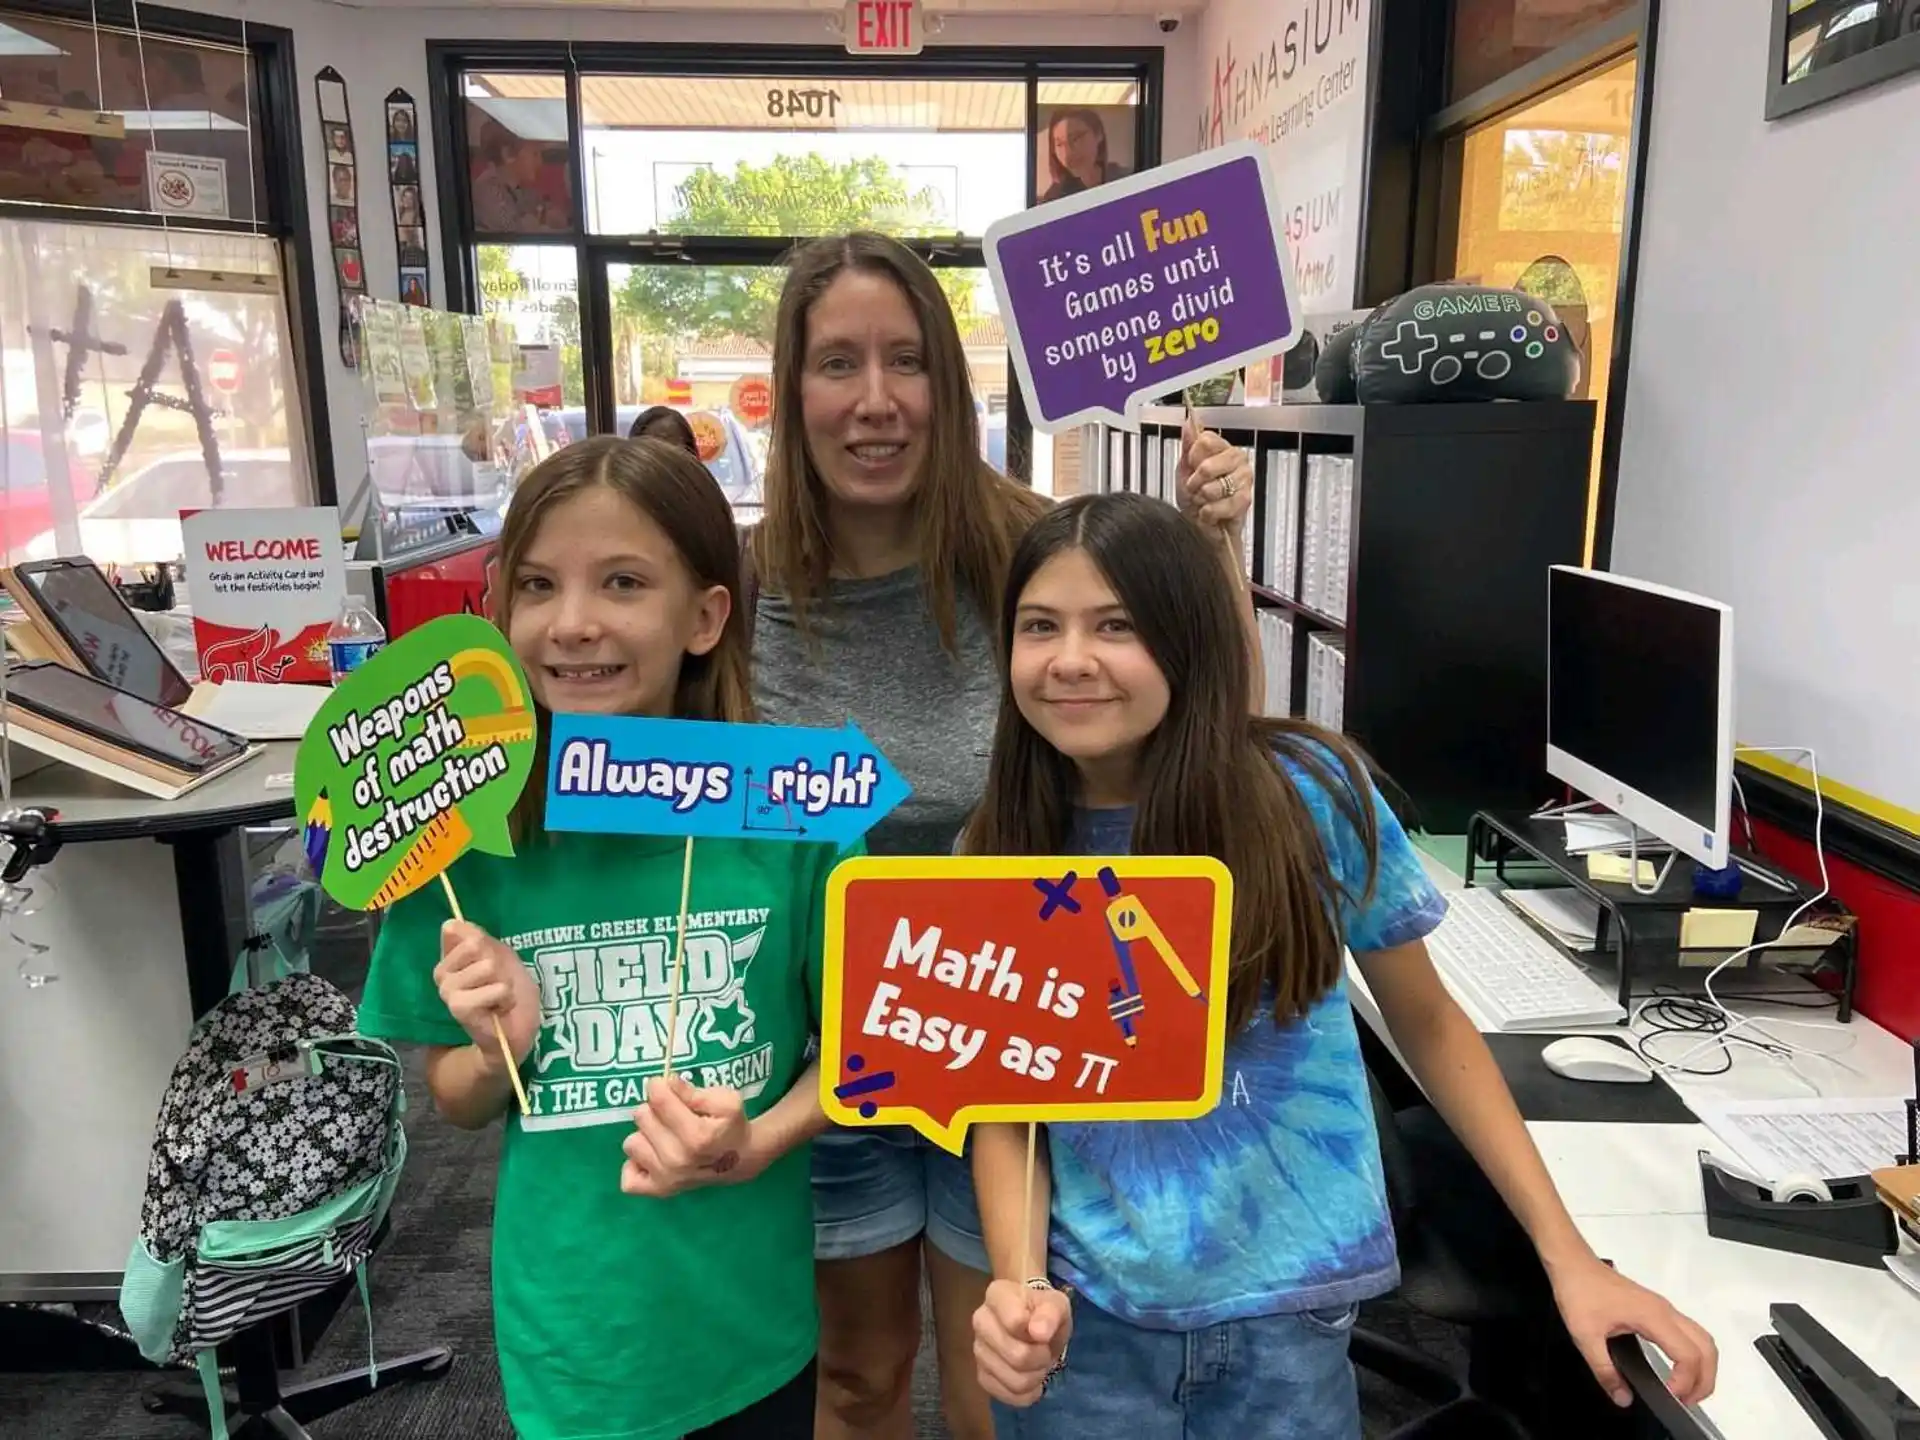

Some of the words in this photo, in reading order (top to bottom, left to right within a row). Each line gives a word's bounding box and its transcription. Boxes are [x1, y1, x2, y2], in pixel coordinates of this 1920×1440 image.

[857, 2, 913, 48] EXIT
[1270, 90, 1315, 144] Learning
[1316, 57, 1357, 110] Center
[1038, 251, 1091, 288] It's
[1102, 231, 1135, 267] all
[1140, 208, 1208, 253] Fun
[1065, 272, 1155, 320] Games
[1163, 245, 1220, 286] unti
[1045, 310, 1161, 366] someone
[1171, 277, 1234, 322] divid
[1413, 294, 1522, 321] GAMER
[1102, 350, 1137, 384] by
[1143, 316, 1220, 364] zero
[205, 538, 322, 562] WELCOME
[209, 572, 232, 581] Grab
[234, 572, 246, 581] an
[247, 570, 283, 581] Activity
[284, 569, 306, 580] Card
[308, 569, 324, 579] and
[214, 583, 228, 593] let
[230, 583, 245, 592] the
[247, 582, 292, 592] festivities
[293, 580, 321, 592] begin!
[330, 661, 456, 764] Weapons
[353, 755, 384, 807] of
[389, 704, 464, 784] math
[558, 739, 731, 811] Always
[770, 754, 879, 814] right
[344, 744, 508, 870] destruction
[590, 918, 649, 940] CREEK
[537, 933, 730, 1011] FIELD
[883, 917, 1024, 1002] Math
[1037, 967, 1086, 1019] is
[572, 998, 700, 1068] DAY
[861, 981, 988, 1071] Easy
[1000, 1035, 1063, 1081] as
[550, 1081, 598, 1113] THE
